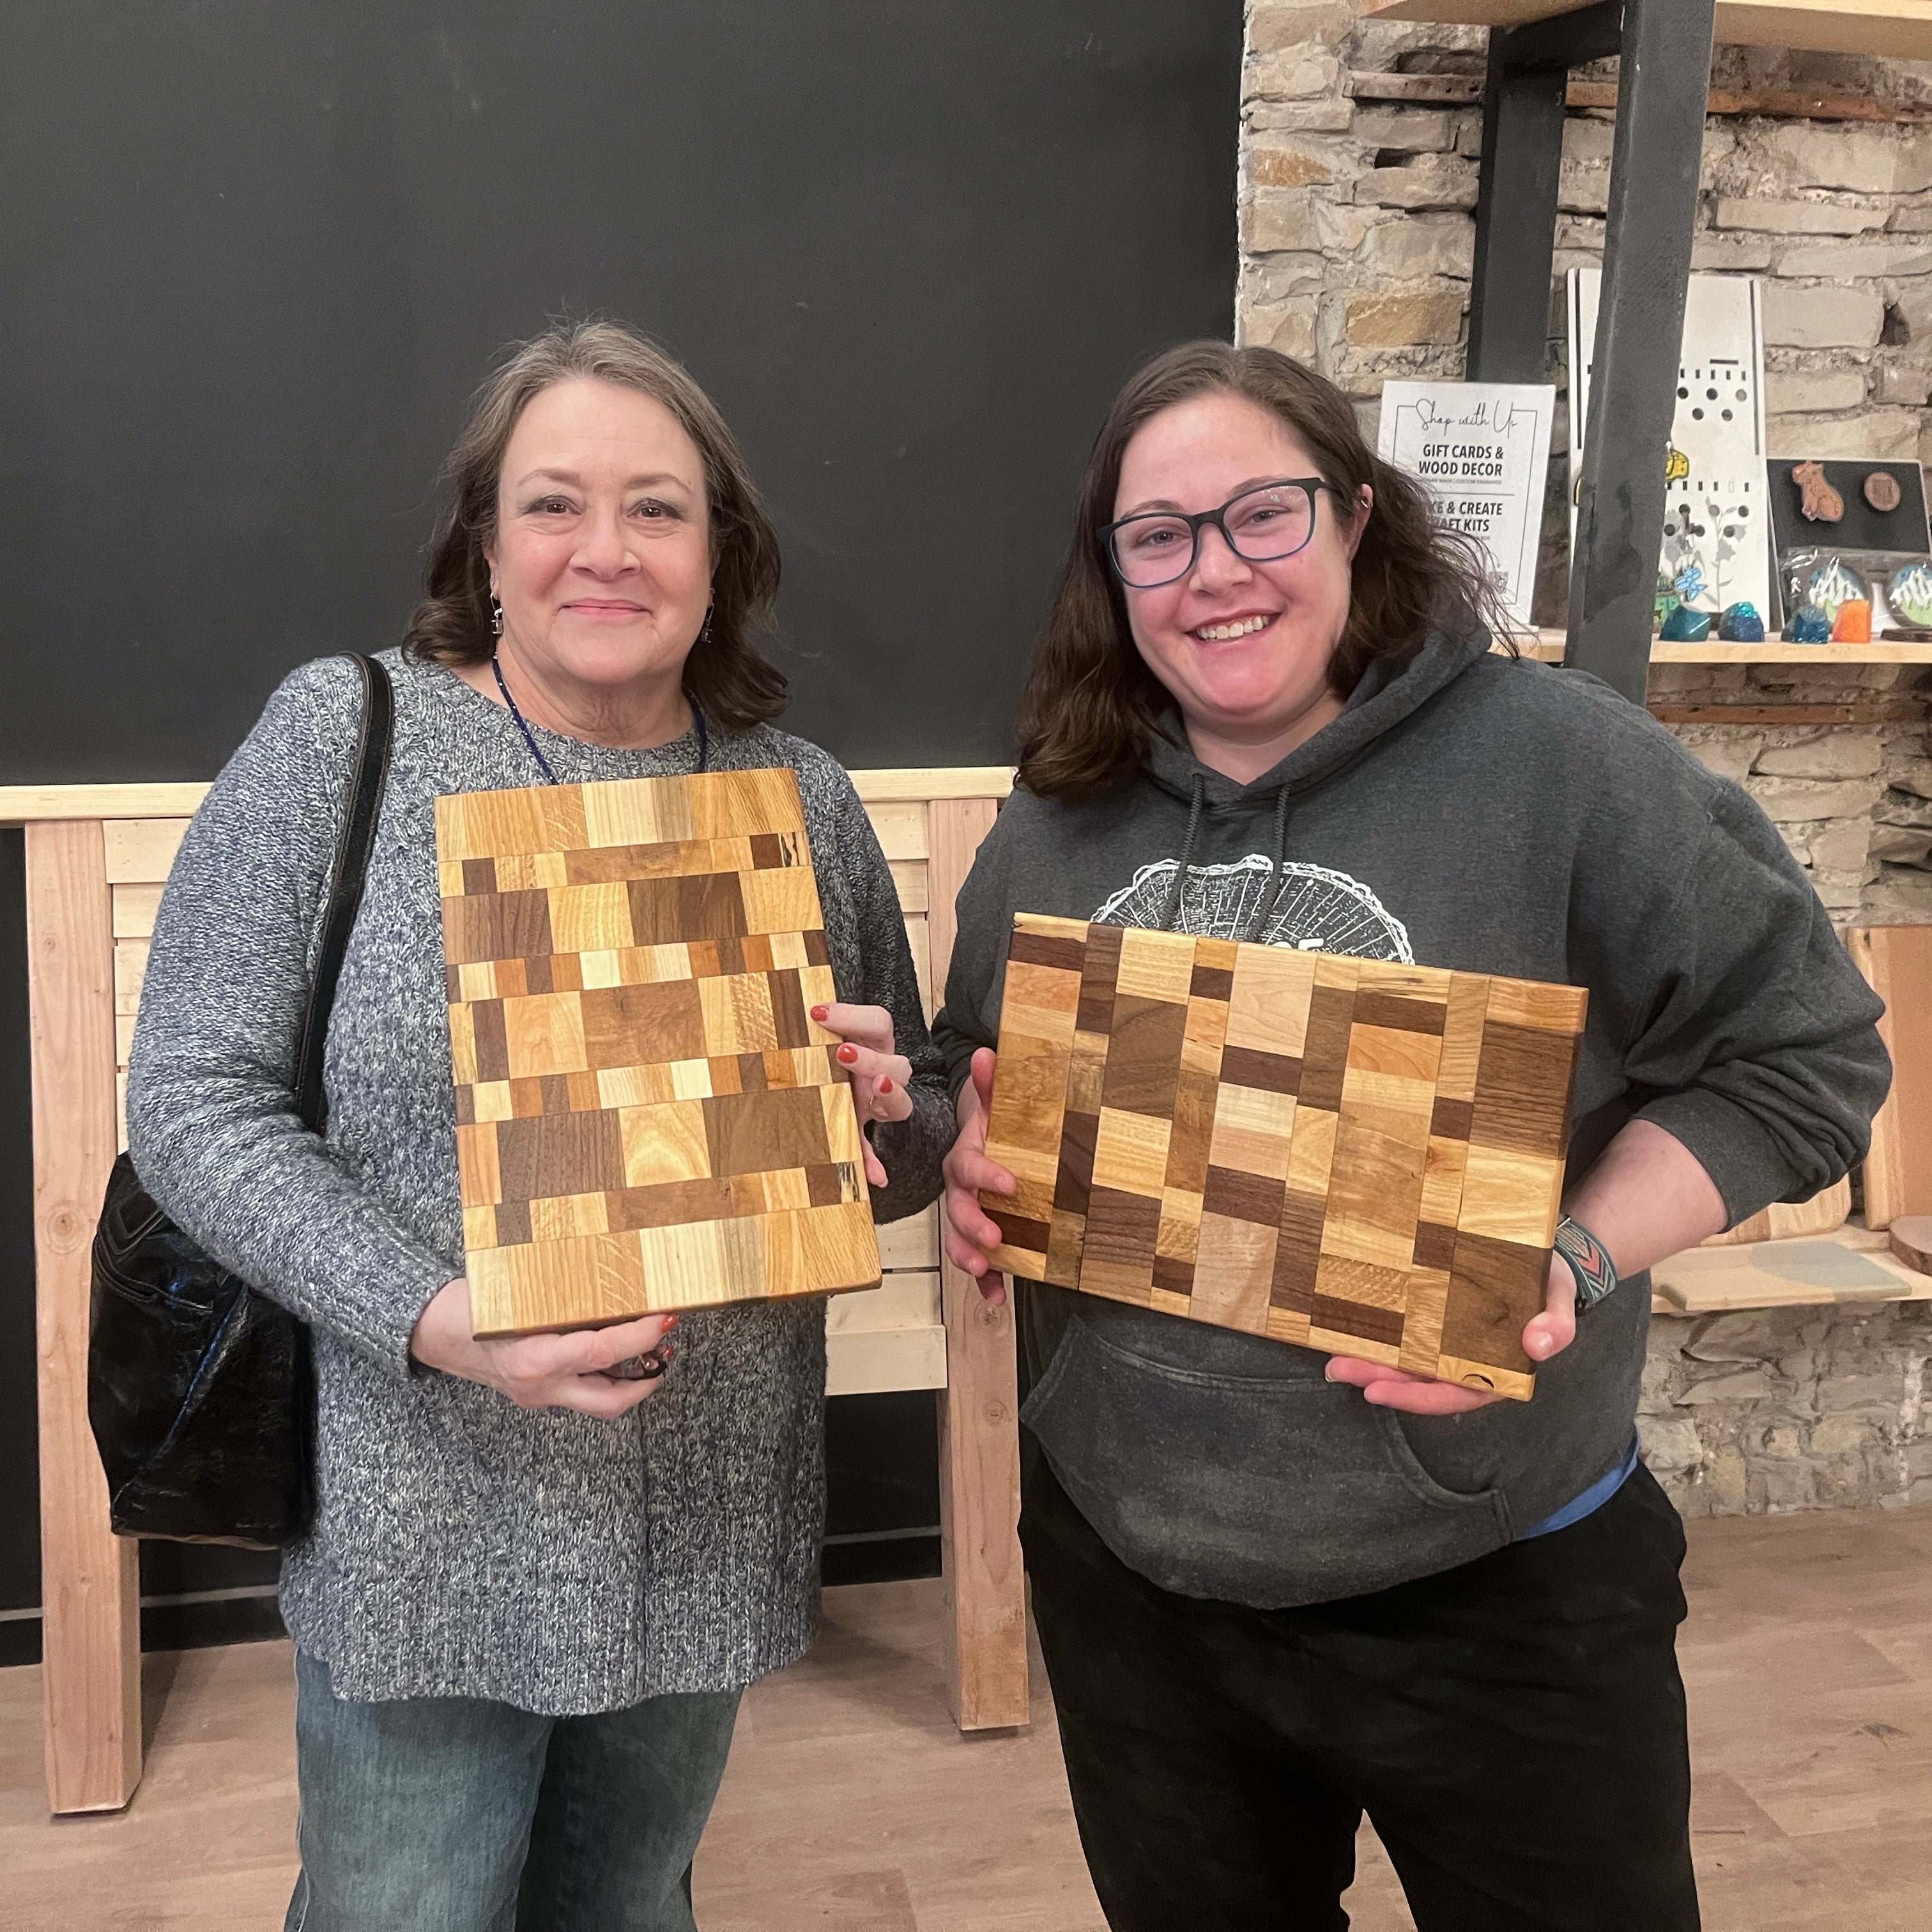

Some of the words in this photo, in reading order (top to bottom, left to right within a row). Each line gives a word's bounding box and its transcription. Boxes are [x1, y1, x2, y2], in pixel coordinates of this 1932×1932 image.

[1416, 399, 1455, 436] Shop
[1459, 402, 1489, 426] with
[1423, 444, 1450, 457] GIFT
[1452, 445, 1492, 459] CARDS
[1495, 446, 1504, 459] &
[1419, 461, 1458, 475] WOOD
[1462, 463, 1502, 476] DECOR
[1446, 501, 1455, 514] &
[1459, 502, 1503, 516] CREATE
[1464, 519, 1490, 532] KITS
